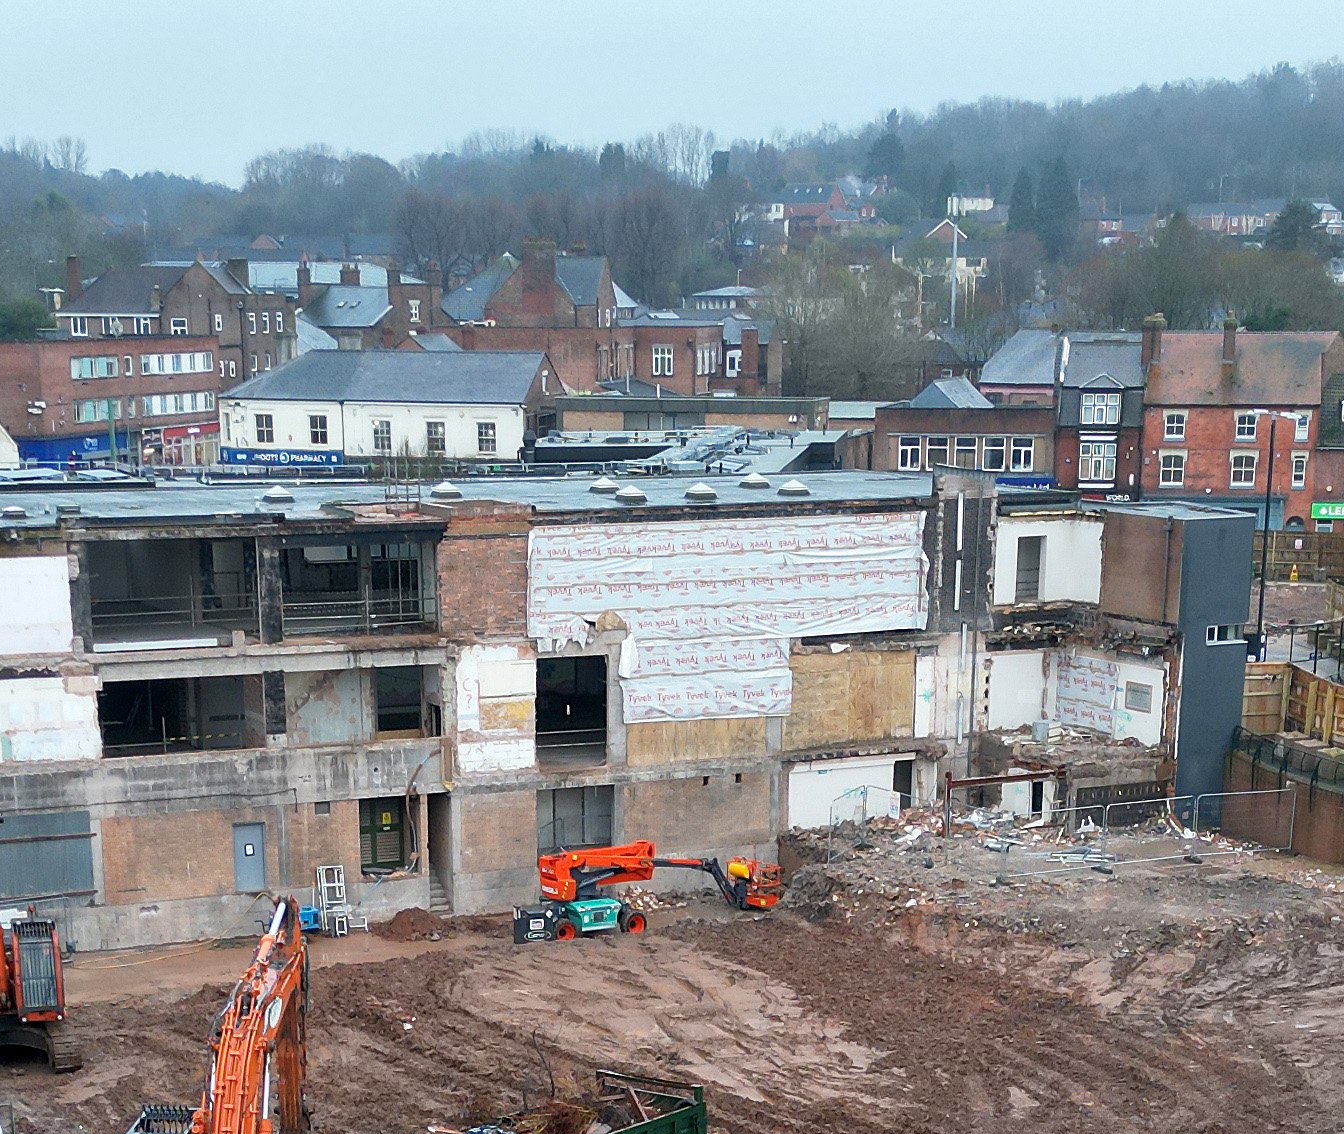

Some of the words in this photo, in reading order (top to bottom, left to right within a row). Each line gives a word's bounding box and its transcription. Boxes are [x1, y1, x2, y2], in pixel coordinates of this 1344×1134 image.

[290, 453, 327, 462] PHARMACY
[647, 656, 671, 667] Tyvek
[675, 654, 699, 665] Tyvek
[704, 652, 727, 663] Tyvek
[733, 651, 755, 662] Tyvek
[761, 649, 783, 660] Tyvek
[628, 693, 653, 704] Tyvek
[657, 692, 681, 702] Tyvek
[686, 690, 709, 701] Tyvek
[714, 689, 738, 700] Tyvek
[743, 688, 766, 699] Tyvek
